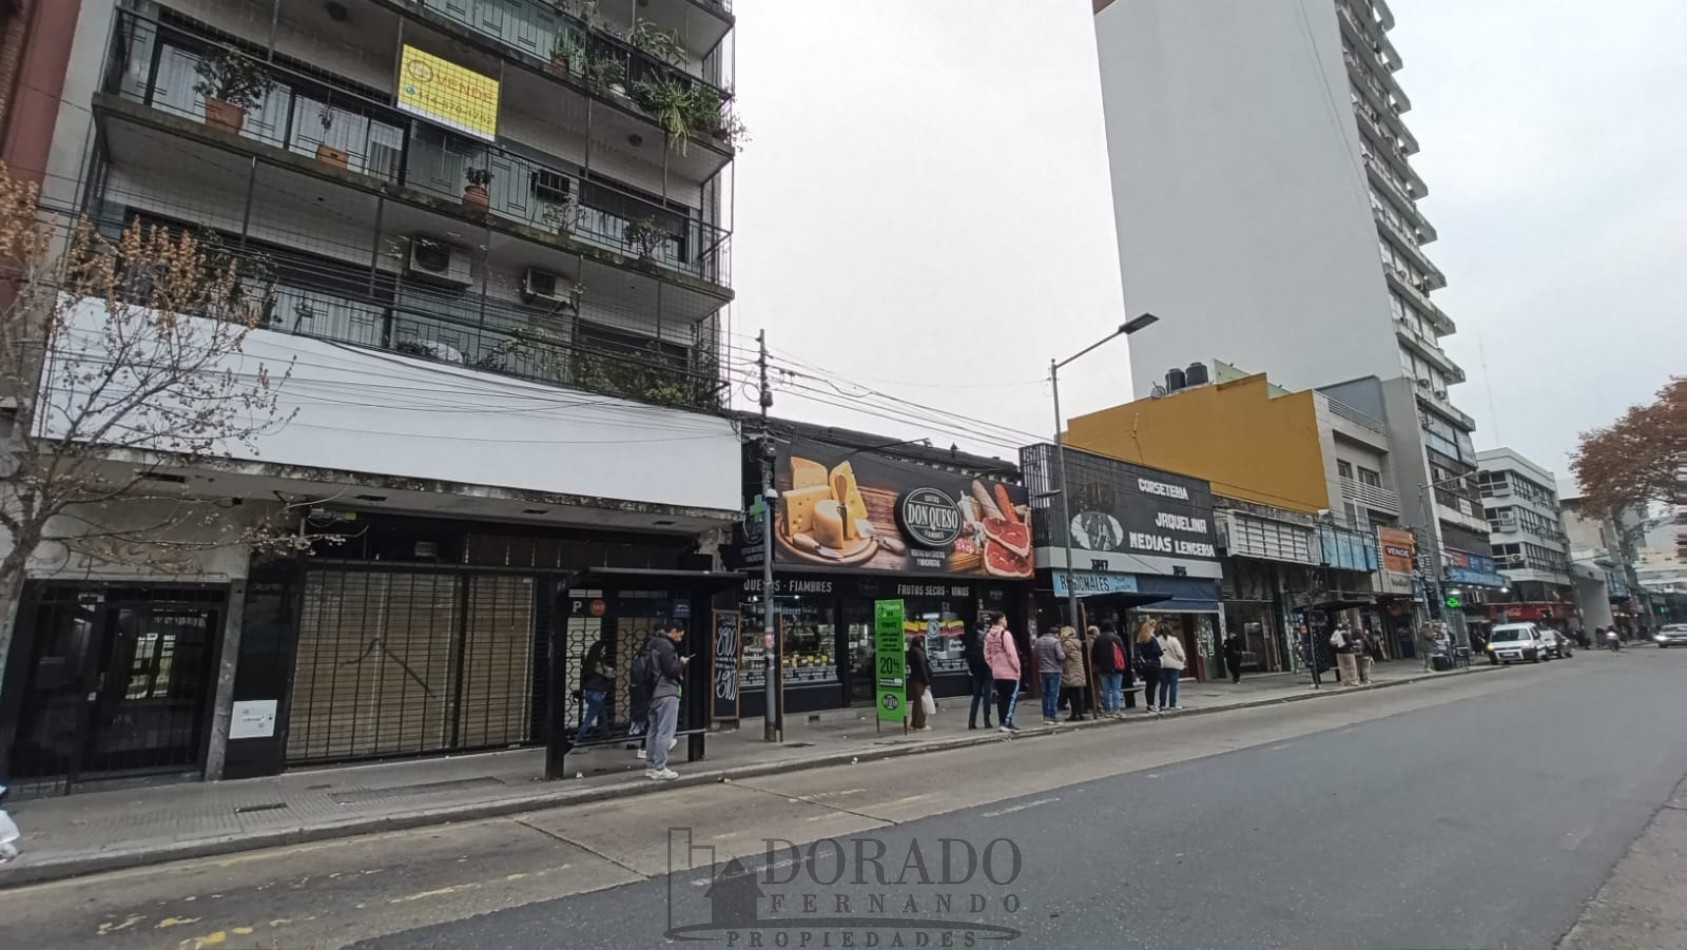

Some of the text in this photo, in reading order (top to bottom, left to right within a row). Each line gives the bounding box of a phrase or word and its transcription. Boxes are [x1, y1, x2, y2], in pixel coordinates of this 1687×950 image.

[436, 74, 493, 104] VENDE
[907, 503, 958, 530] DON QUESO
[1129, 532, 1216, 557] MEDIAS LENCERIA
[743, 578, 832, 593] QUES FIAMBRES
[897, 584, 969, 597] FRUTOS SECOS VINOS
[572, 600, 583, 613] P
